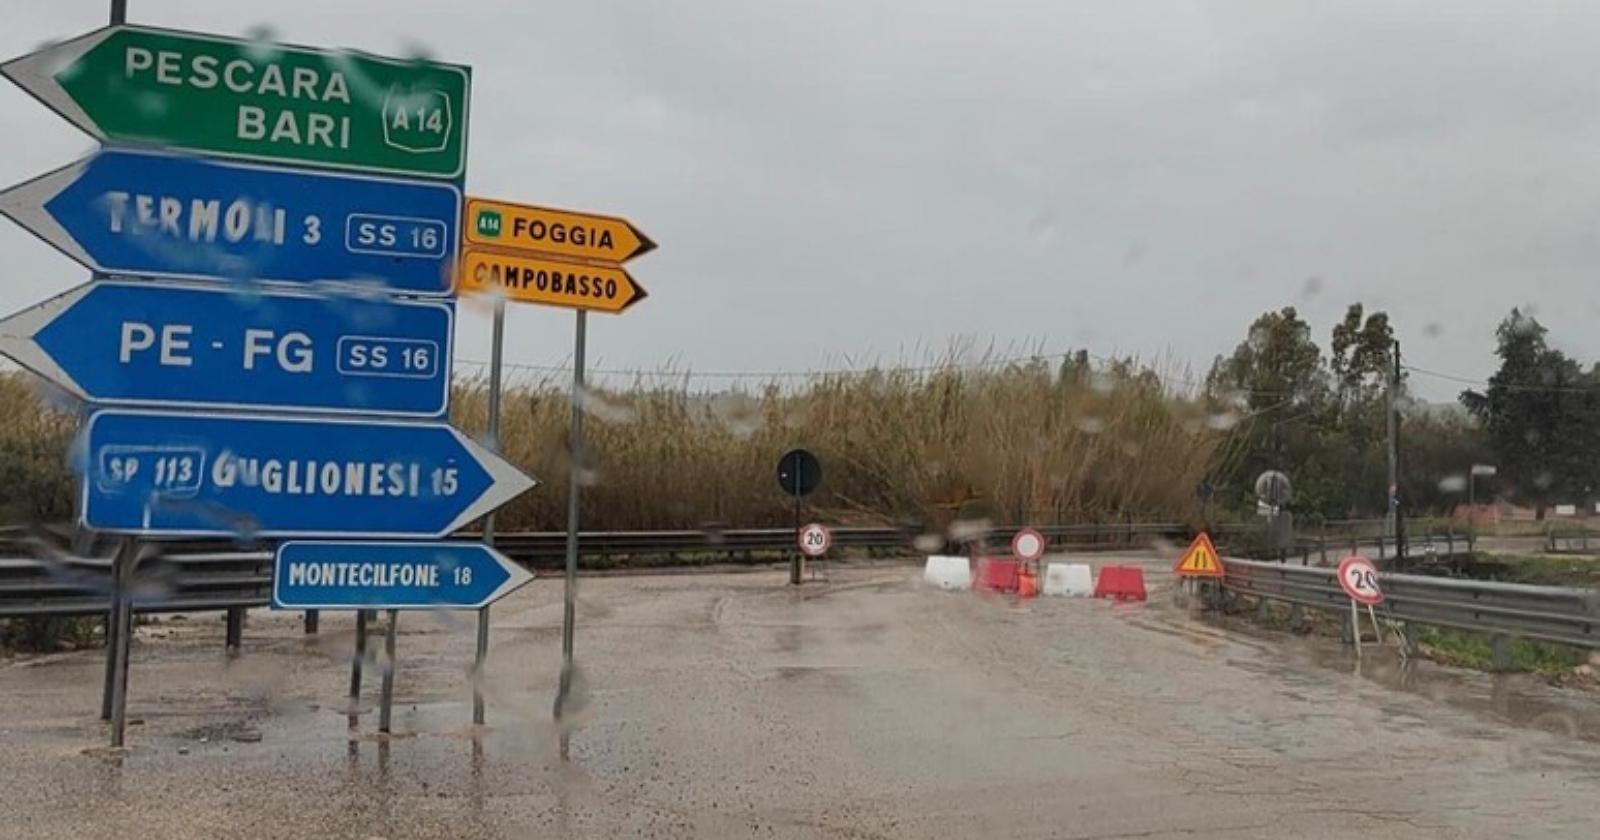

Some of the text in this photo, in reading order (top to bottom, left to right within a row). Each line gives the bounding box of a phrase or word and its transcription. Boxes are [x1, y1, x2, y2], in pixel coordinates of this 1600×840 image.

[124, 47, 351, 104] PESCARA
[236, 107, 350, 149] BARI
[391, 106, 443, 134] A 14
[302, 215, 322, 244] 3
[357, 223, 438, 249] SS 16
[478, 217, 614, 249] A14 FOGGIA
[473, 262, 618, 299] CAMPOBASSO
[119, 322, 193, 366] PE
[242, 329, 315, 373] FG
[348, 344, 429, 370] SS 16
[109, 457, 193, 486] SP 113
[430, 467, 458, 496] 15
[807, 532, 824, 546] 20
[288, 562, 472, 588] MONTECILFONE 18
[1351, 569, 1376, 590] 20
